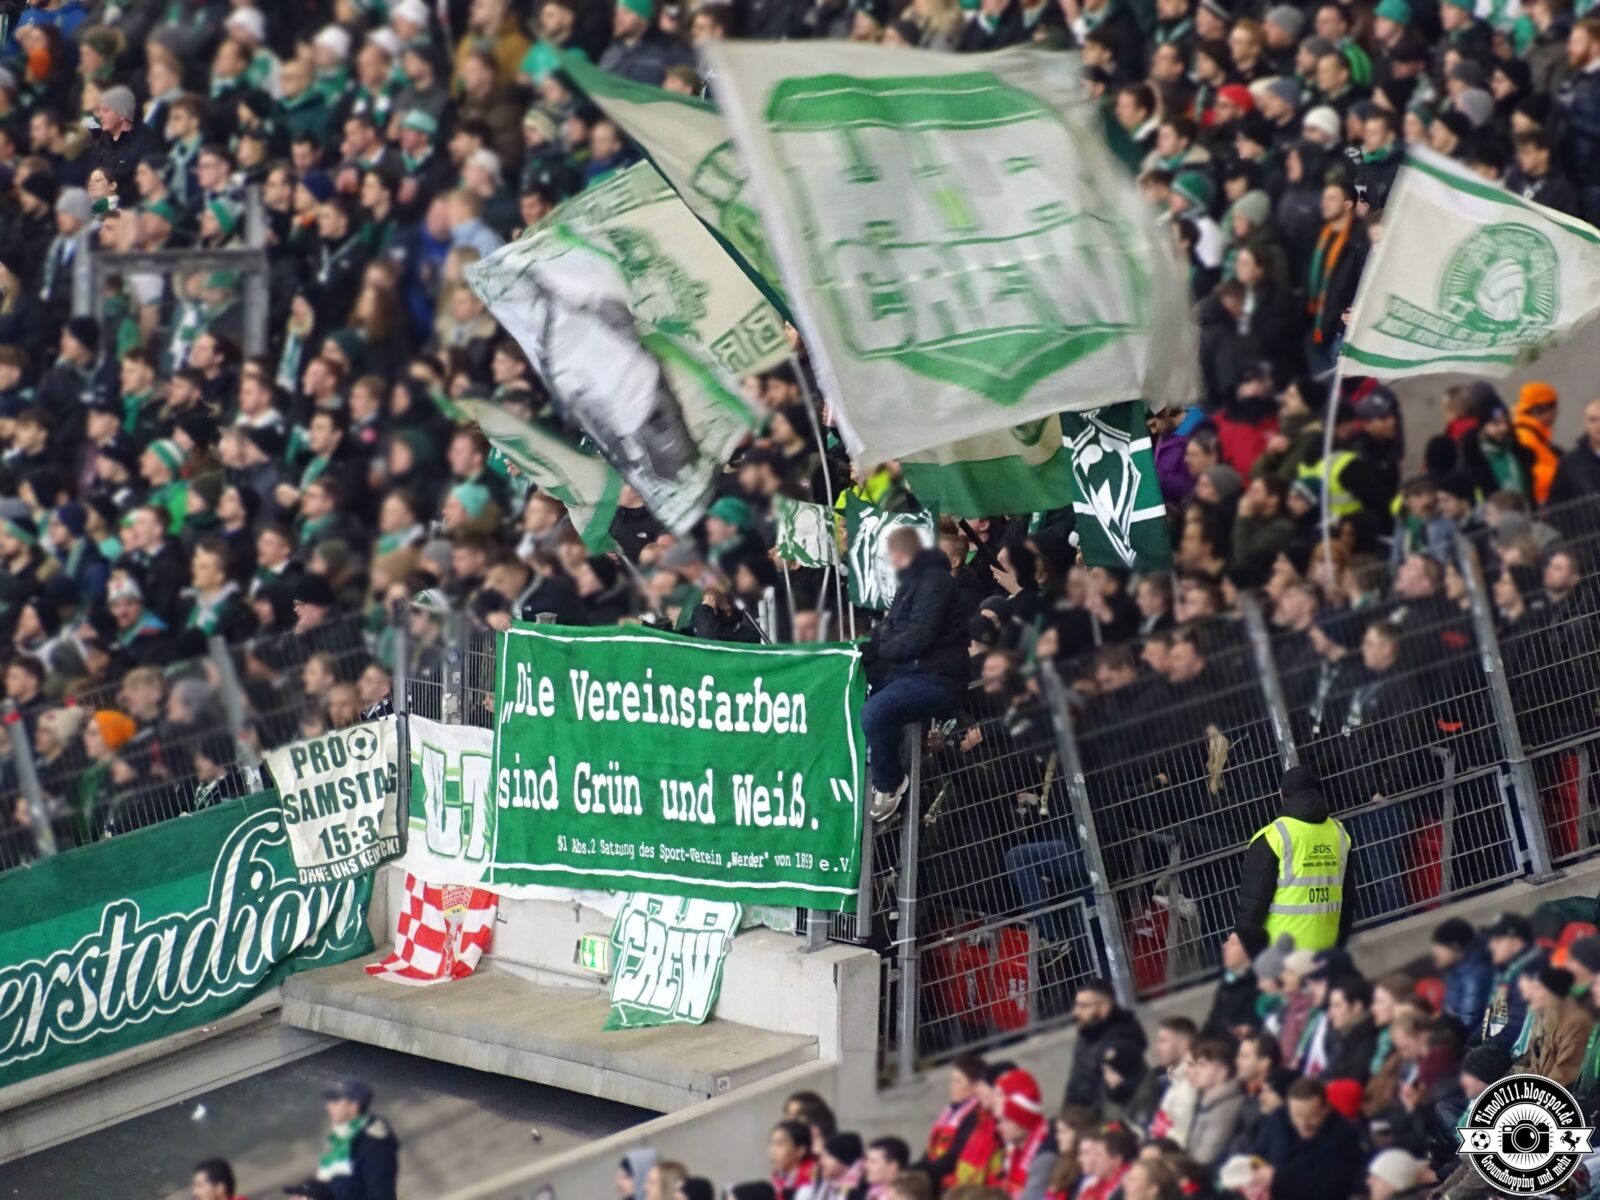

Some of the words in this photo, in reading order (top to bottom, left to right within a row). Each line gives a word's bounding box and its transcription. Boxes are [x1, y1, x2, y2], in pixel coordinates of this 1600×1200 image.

[569, 668, 807, 733] Vereinsfarben
[290, 735, 347, 779] PRO
[498, 752, 558, 811] sind
[574, 761, 643, 816] Grün
[660, 768, 716, 824] und
[331, 858, 359, 880] UNS
[572, 838, 596, 854] Abs.2
[600, 839, 635, 860] Satzung
[640, 841, 655, 858] des
[660, 843, 723, 866] Sport-Verein
[774, 854, 792, 867] von
[1309, 887, 1330, 904] 0733
[611, 909, 726, 1020] CREW
